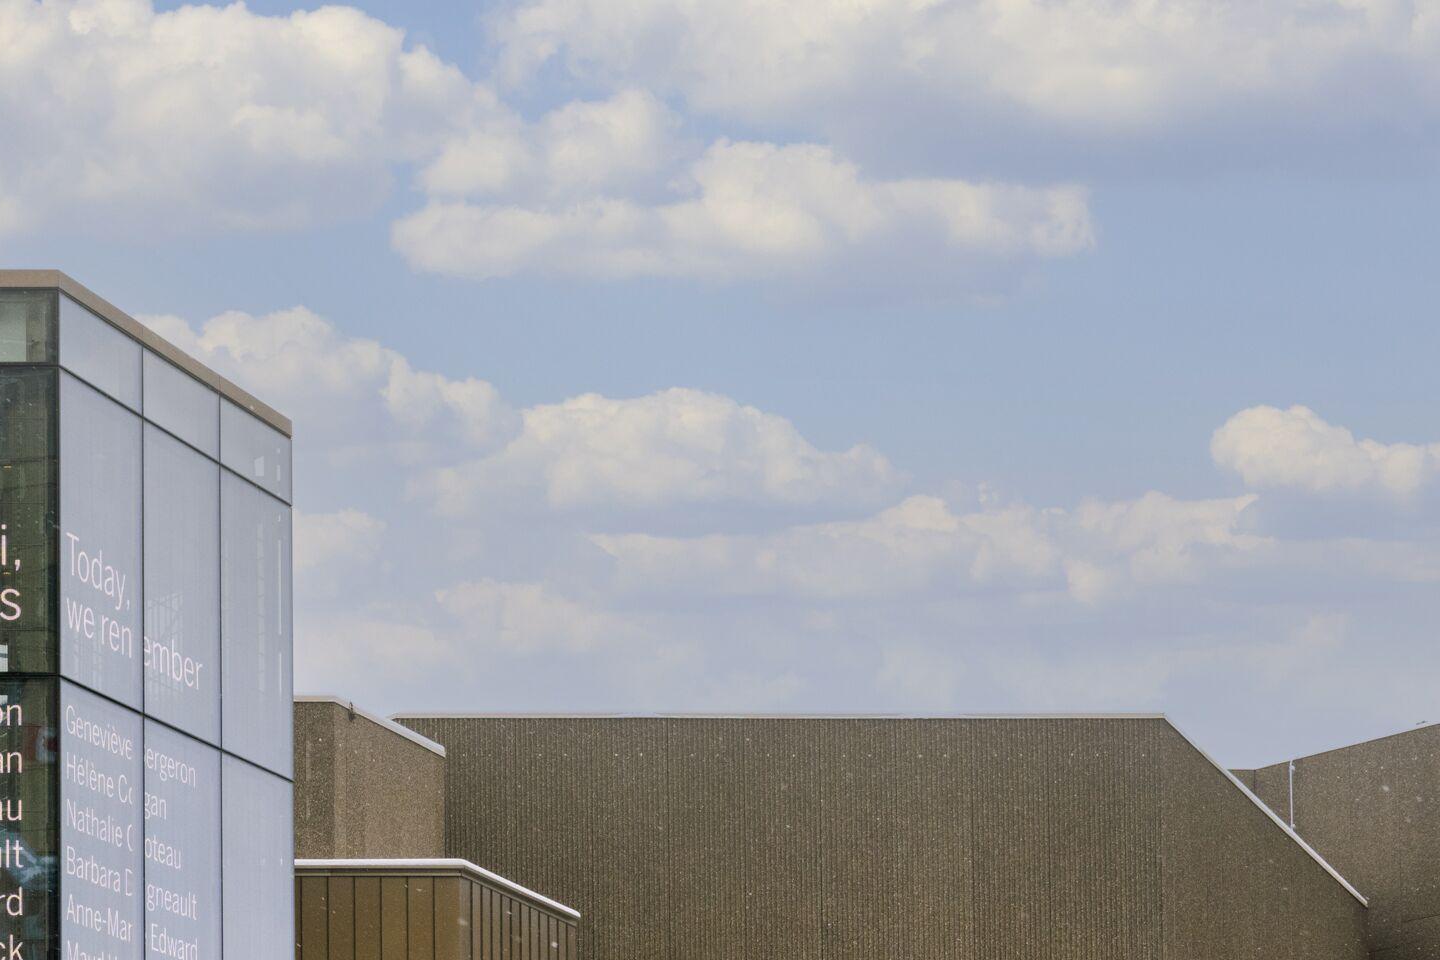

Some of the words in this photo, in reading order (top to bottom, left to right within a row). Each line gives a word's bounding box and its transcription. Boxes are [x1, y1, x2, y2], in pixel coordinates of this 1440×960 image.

[66, 532, 130, 610] Today,
[66, 598, 95, 638] we
[66, 705, 132, 760] Geneviève
[144, 743, 197, 788] ergeron
[66, 752, 114, 798] Hélène
[119, 774, 167, 820] Cgan
[66, 799, 123, 848] Nathalie
[127, 823, 181, 870] Coteau
[66, 846, 121, 892] Barbara
[125, 868, 198, 920] Dgneault
[66, 894, 133, 942] Anne-Mar
